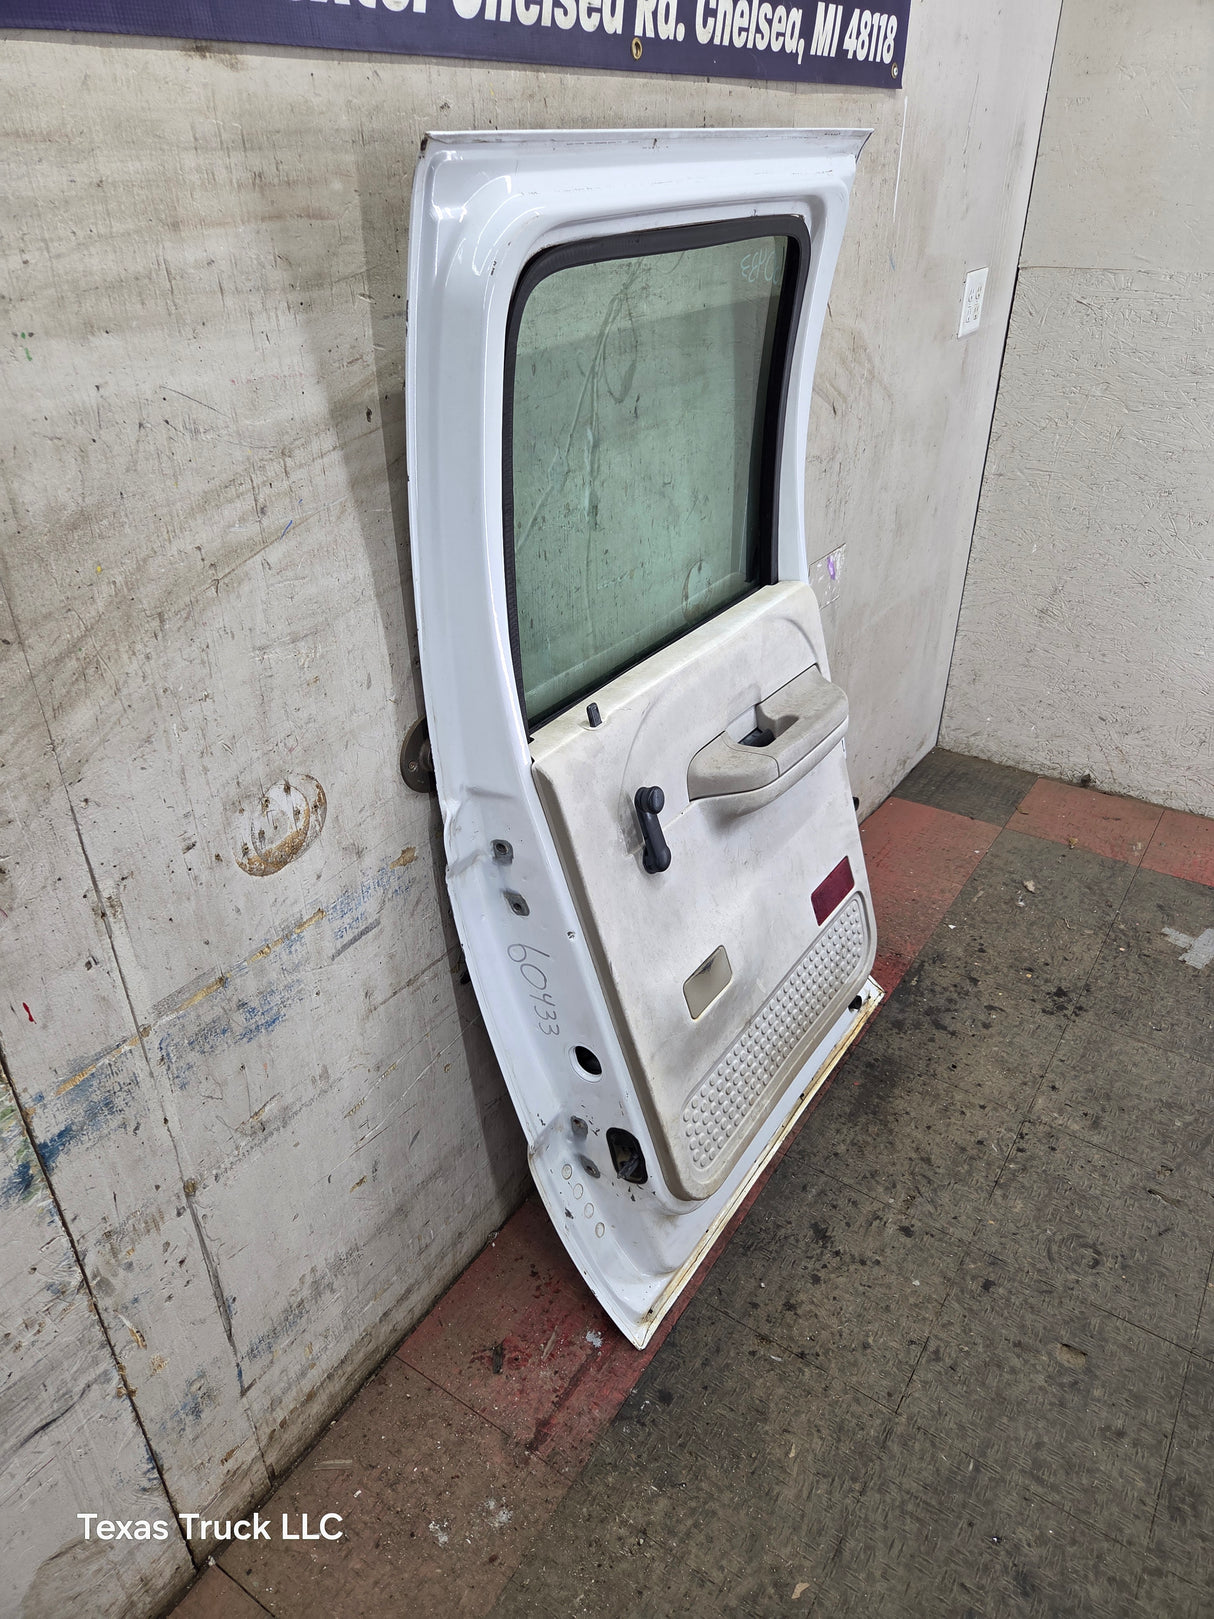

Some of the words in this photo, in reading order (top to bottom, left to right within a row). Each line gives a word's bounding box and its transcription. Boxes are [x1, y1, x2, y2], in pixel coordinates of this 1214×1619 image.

[634, 0, 685, 41] Rd.
[695, 0, 805, 64] Chelsea,
[810, 2, 843, 57] MI
[842, 8, 897, 64] 48118
[507, 943, 560, 1036] 60433
